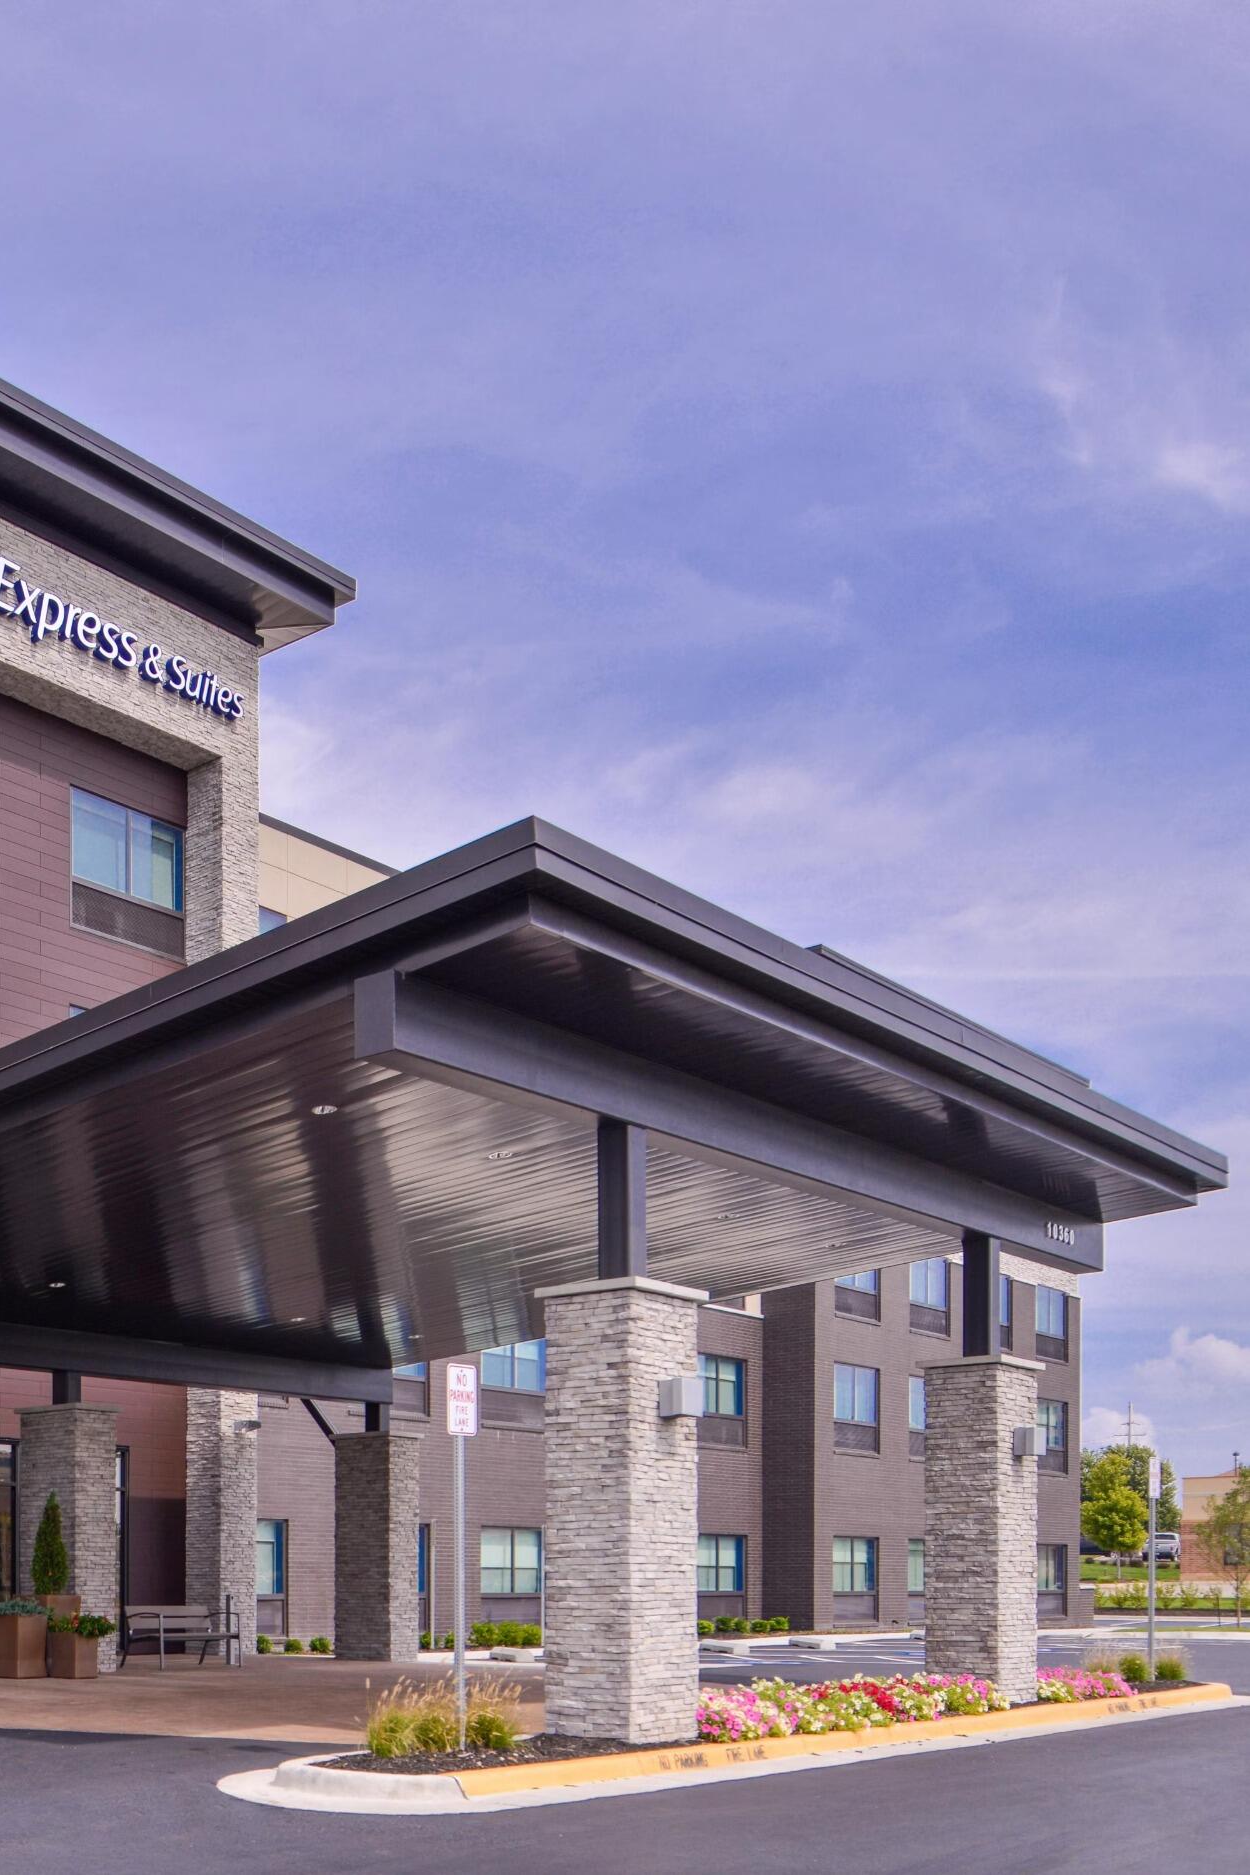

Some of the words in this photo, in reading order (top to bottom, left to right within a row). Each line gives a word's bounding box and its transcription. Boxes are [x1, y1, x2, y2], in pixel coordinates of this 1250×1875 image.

[139, 643, 163, 684] &
[164, 655, 245, 721] Suites
[1046, 1221, 1075, 1246] 10360
[456, 1373, 467, 1387] NO
[450, 1389, 474, 1403] PARKING
[455, 1405, 469, 1416] FIRE
[454, 1418, 469, 1427] LANE
